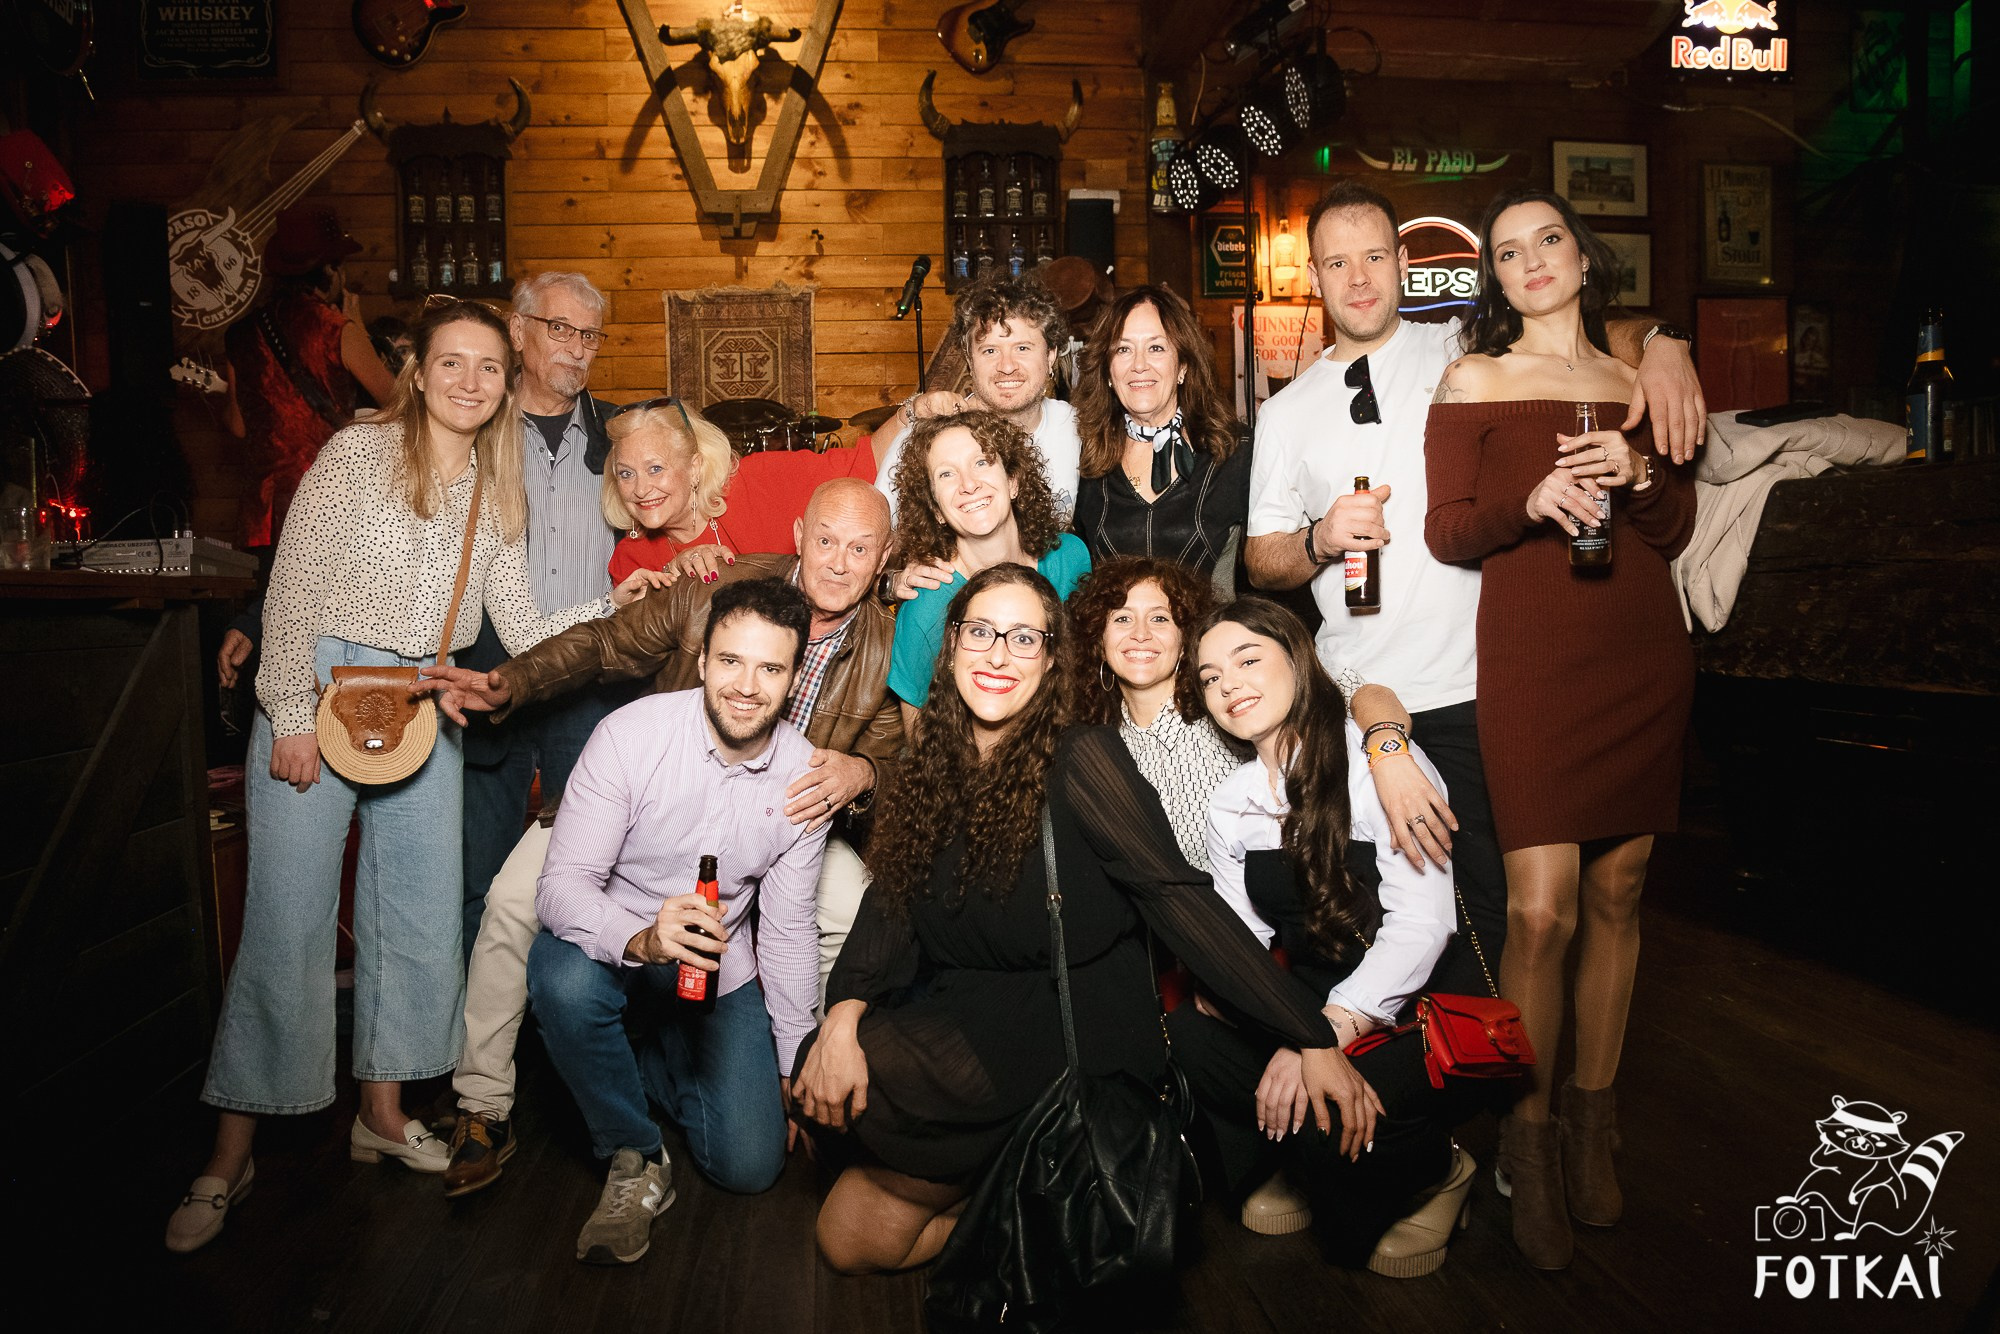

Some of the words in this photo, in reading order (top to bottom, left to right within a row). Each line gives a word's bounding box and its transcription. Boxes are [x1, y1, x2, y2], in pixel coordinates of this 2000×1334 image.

[157, 6, 255, 21] WHISKEY
[178, 28, 209, 36] DANIEL
[210, 28, 259, 36] DISTILLERY
[1671, 35, 1731, 70] Red
[1731, 37, 1788, 72] Bull
[1391, 147, 1418, 171] EL
[1424, 148, 1476, 173] PASO
[223, 255, 237, 271] 66
[1401, 267, 1480, 297] EPS
[186, 285, 201, 300] 18
[239, 279, 256, 303] BAR
[1253, 335, 1265, 346] IS
[1272, 334, 1305, 346] GOOD
[1254, 349, 1278, 361] FOR
[1280, 349, 1305, 361] YOU
